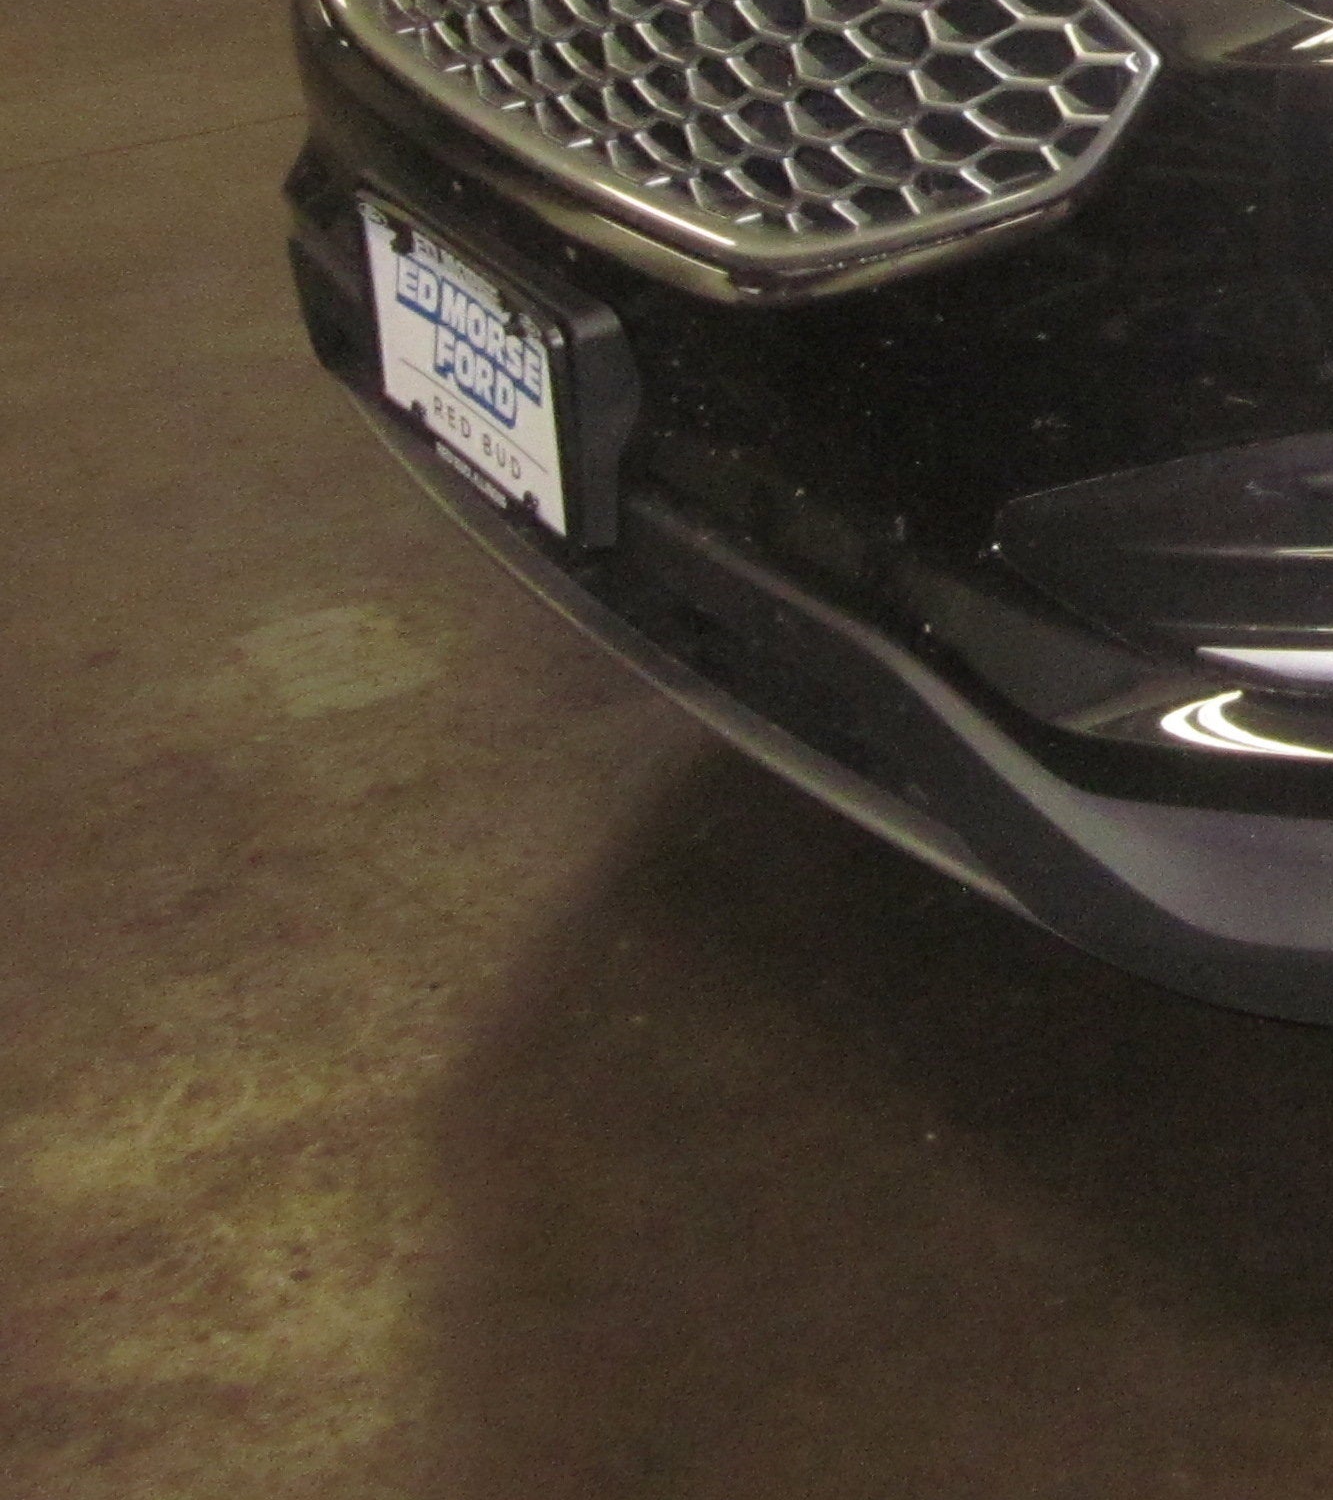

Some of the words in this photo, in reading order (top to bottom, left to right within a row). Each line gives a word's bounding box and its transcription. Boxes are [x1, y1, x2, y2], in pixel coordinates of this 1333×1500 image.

[397, 254, 441, 325] ED
[438, 275, 544, 408] MORSE
[434, 323, 518, 430] FORD
[433, 395, 471, 439] RED
[482, 432, 521, 480] BUD
